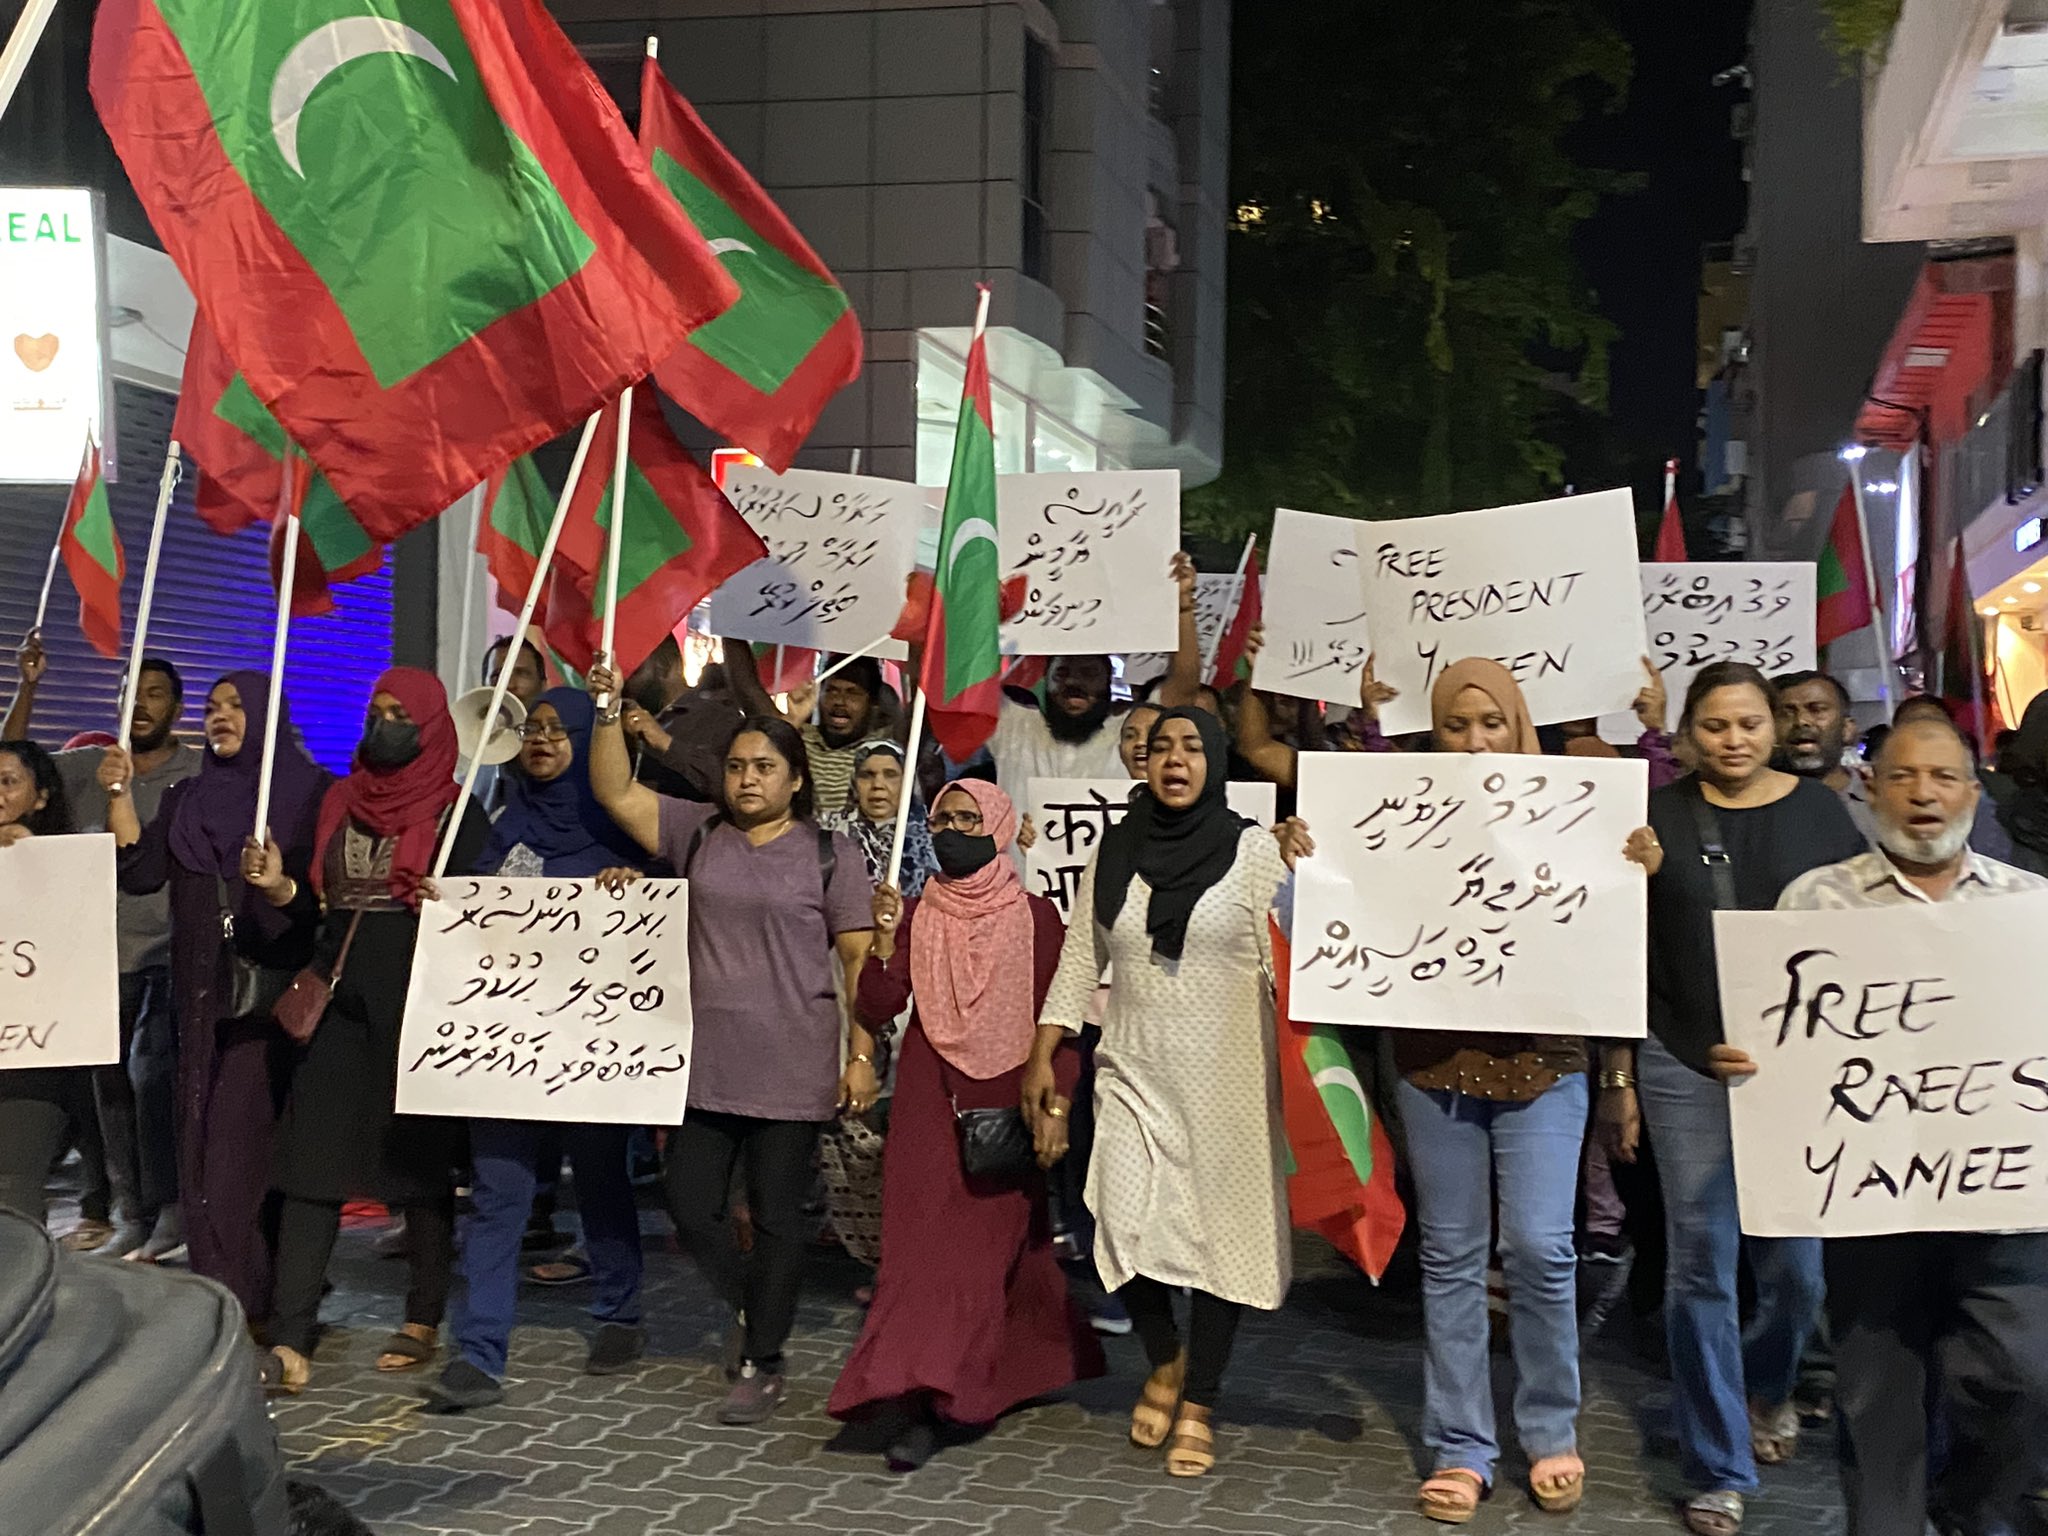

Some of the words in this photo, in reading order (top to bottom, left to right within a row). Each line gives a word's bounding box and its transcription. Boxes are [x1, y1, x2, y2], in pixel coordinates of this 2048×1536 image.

[0, 212, 81, 243] EAL
[1376, 542, 1446, 579] FREE
[1408, 571, 1587, 624] PRESIDENT
[1761, 949, 1956, 1048] FREE
[1825, 1056, 2048, 1123] RAEES
[1805, 1137, 2048, 1219] YAMEE
